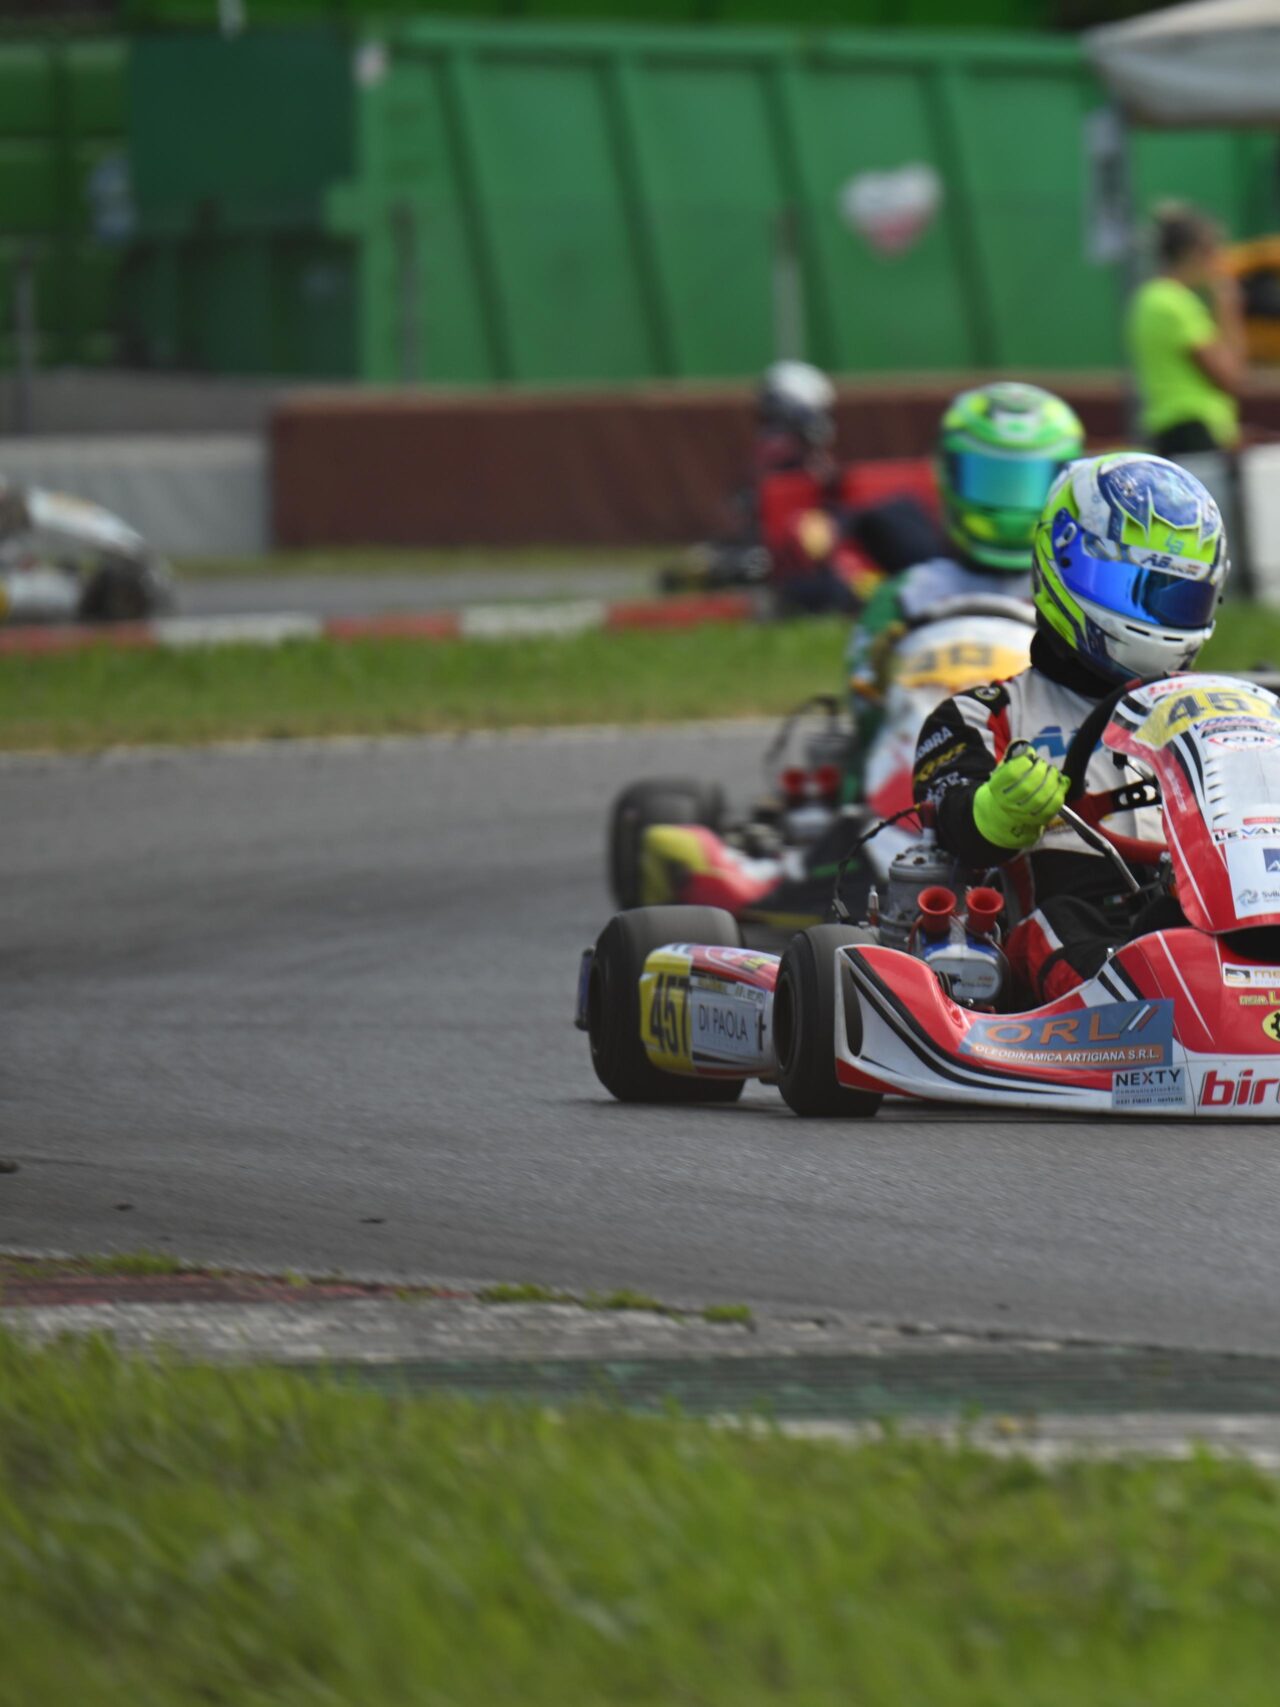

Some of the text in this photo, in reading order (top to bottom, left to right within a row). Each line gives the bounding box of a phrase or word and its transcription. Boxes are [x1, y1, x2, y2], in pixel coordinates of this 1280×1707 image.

[699, 1004, 710, 1032] DI
[713, 1007, 749, 1041] PAOLA
[986, 1012, 1119, 1044] ORL
[974, 1045, 1159, 1063] OLEODINAMICA ARTIGIANA S.R.L.
[1115, 1069, 1181, 1087] NEXTY
